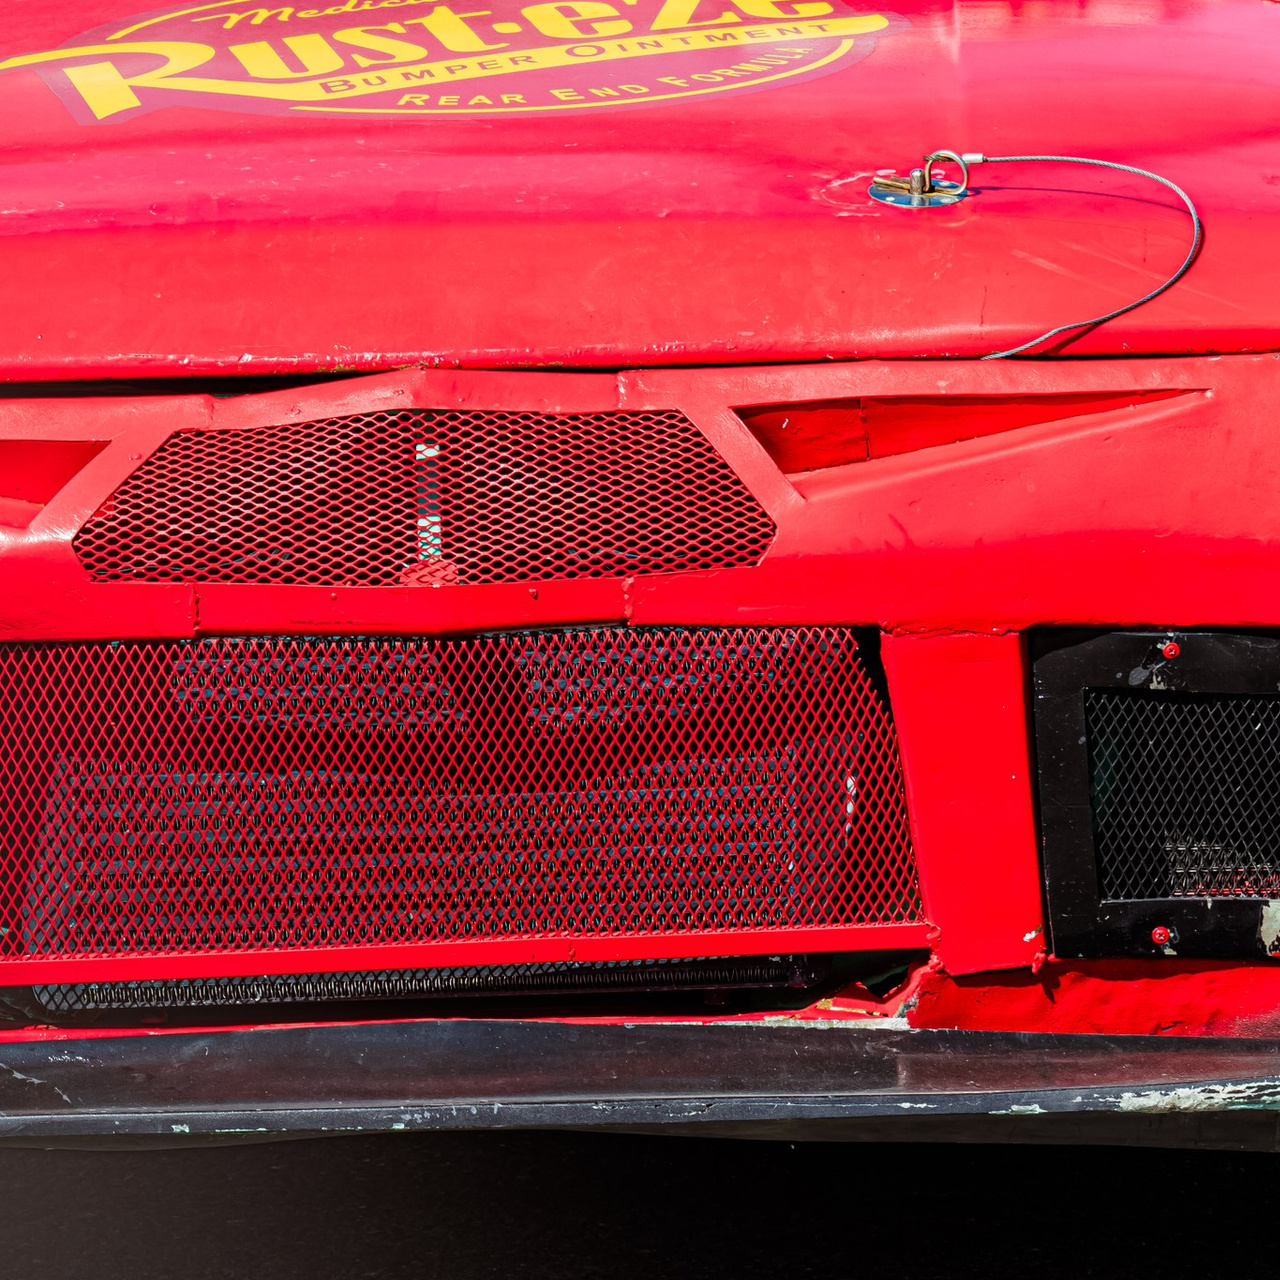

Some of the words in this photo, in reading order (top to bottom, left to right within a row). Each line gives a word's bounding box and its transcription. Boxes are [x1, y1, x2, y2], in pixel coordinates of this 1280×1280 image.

[318, 55, 534, 94] BUMPER
[565, 23, 832, 57] OINTMENT
[396, 93, 528, 107] REAR
[549, 81, 651, 102] END
[655, 46, 814, 89] FORMULA
